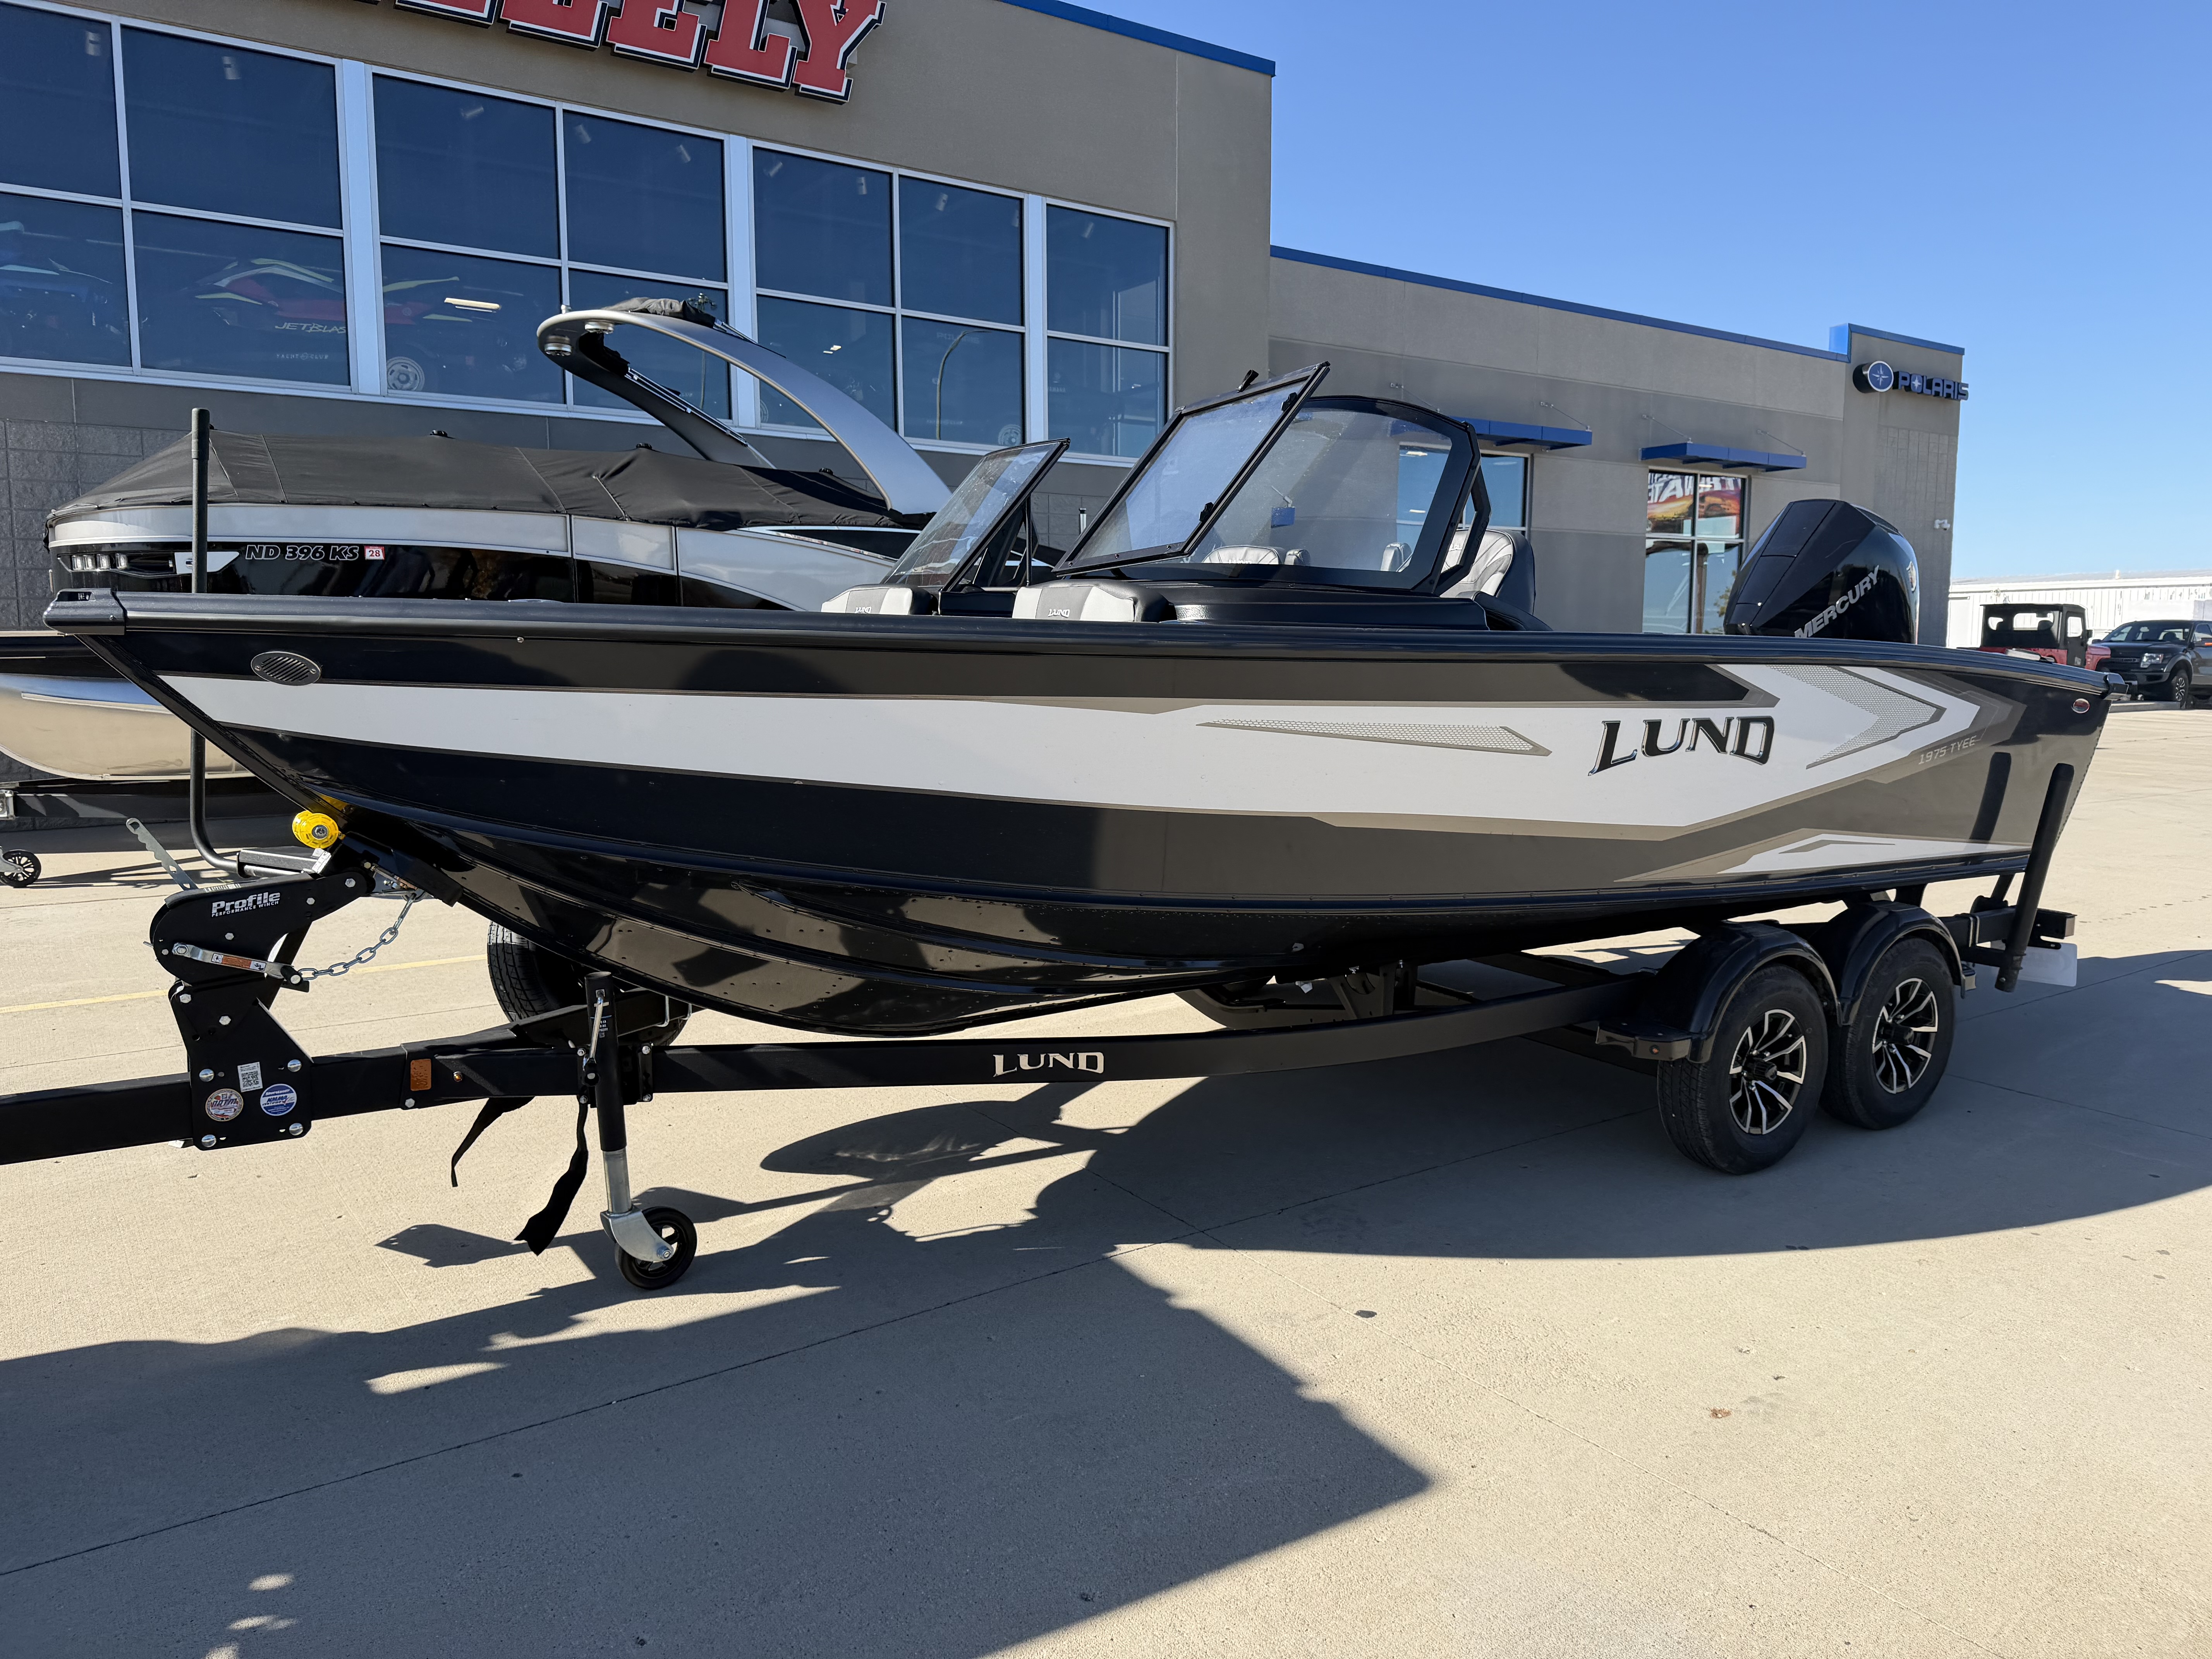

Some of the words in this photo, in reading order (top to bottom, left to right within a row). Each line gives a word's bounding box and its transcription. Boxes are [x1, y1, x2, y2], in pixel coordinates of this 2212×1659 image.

[1898, 370, 1969, 401] POLARIS
[245, 545, 280, 561] ND
[285, 545, 325, 561] 396
[330, 545, 359, 561] KS
[1048, 608, 1070, 618] LUND
[1794, 565, 1879, 639] MERCURY
[1588, 716, 1774, 776] LUND
[1918, 746, 1947, 765] 1975
[1950, 735, 1977, 754] TYEE
[212, 892, 280, 914] Profile
[212, 905, 256, 917] PERFORMANCE
[993, 1051, 1104, 1077] LUND
